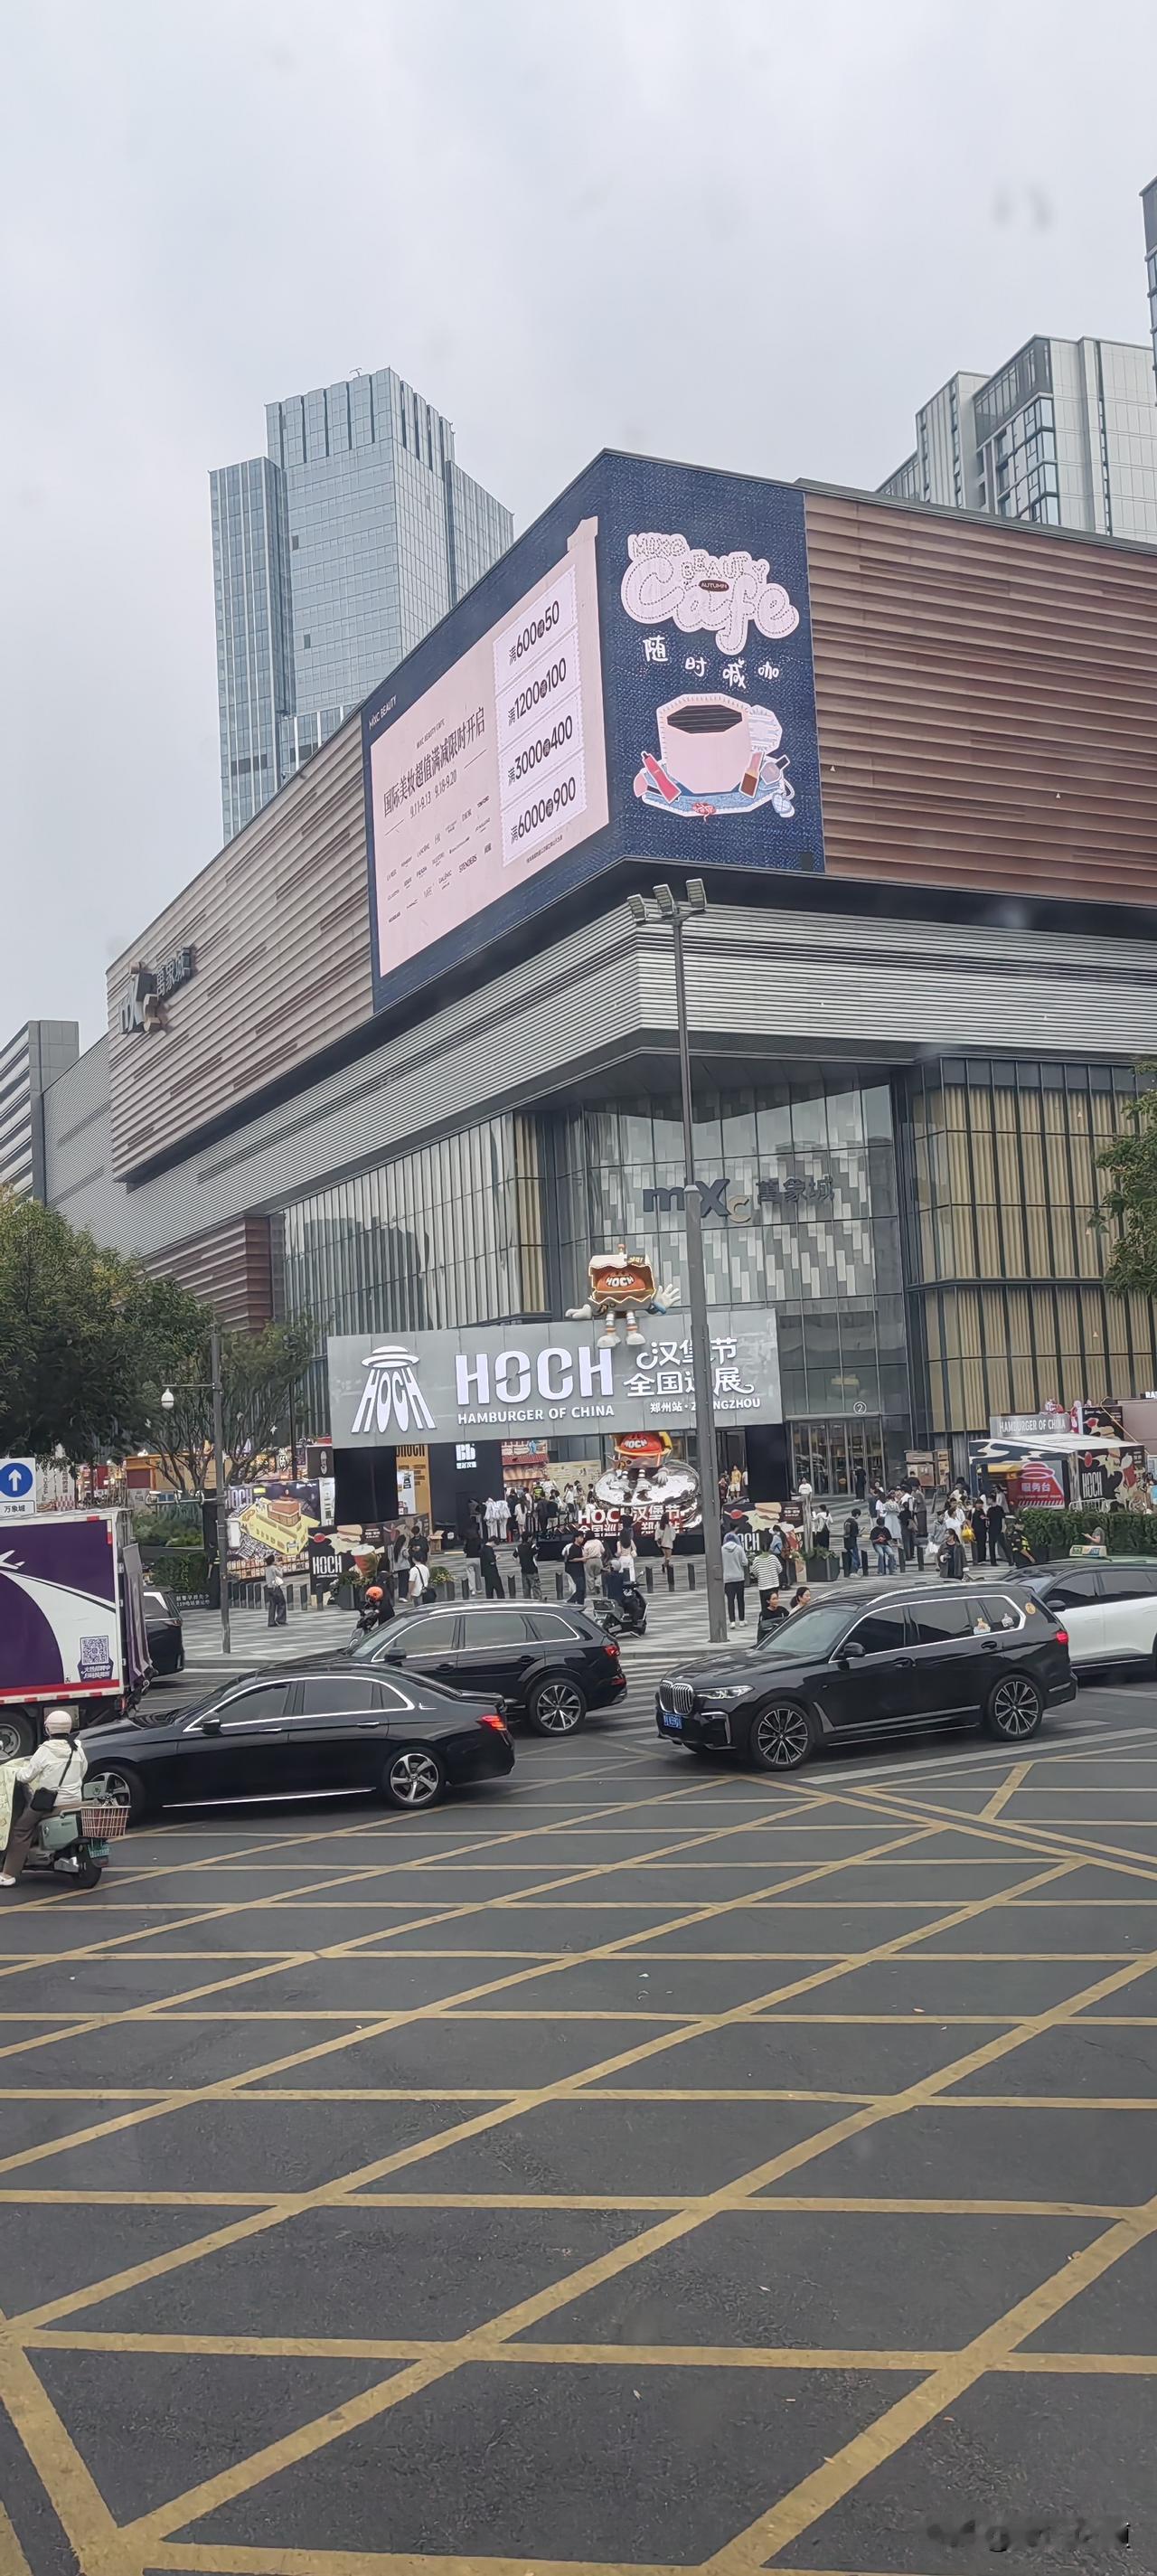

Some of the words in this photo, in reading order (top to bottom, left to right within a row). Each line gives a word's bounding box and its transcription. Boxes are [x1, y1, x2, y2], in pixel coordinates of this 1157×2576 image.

[455, 1346, 615, 1406] HOCH
[351, 1366, 437, 1434] HOCH
[457, 1407, 543, 1425] HAMBURGER
[548, 1407, 567, 1420] OF
[571, 1404, 615, 1419] CHINA
[999, 1420, 1038, 1433] HAMBURGER
[1039, 1420, 1047, 1430] OF
[1048, 1419, 1066, 1430] CHINA
[1082, 1471, 1103, 1498] HOCH
[4, 1505, 26, 1514] 万象城
[312, 1554, 343, 1576] HOCH
